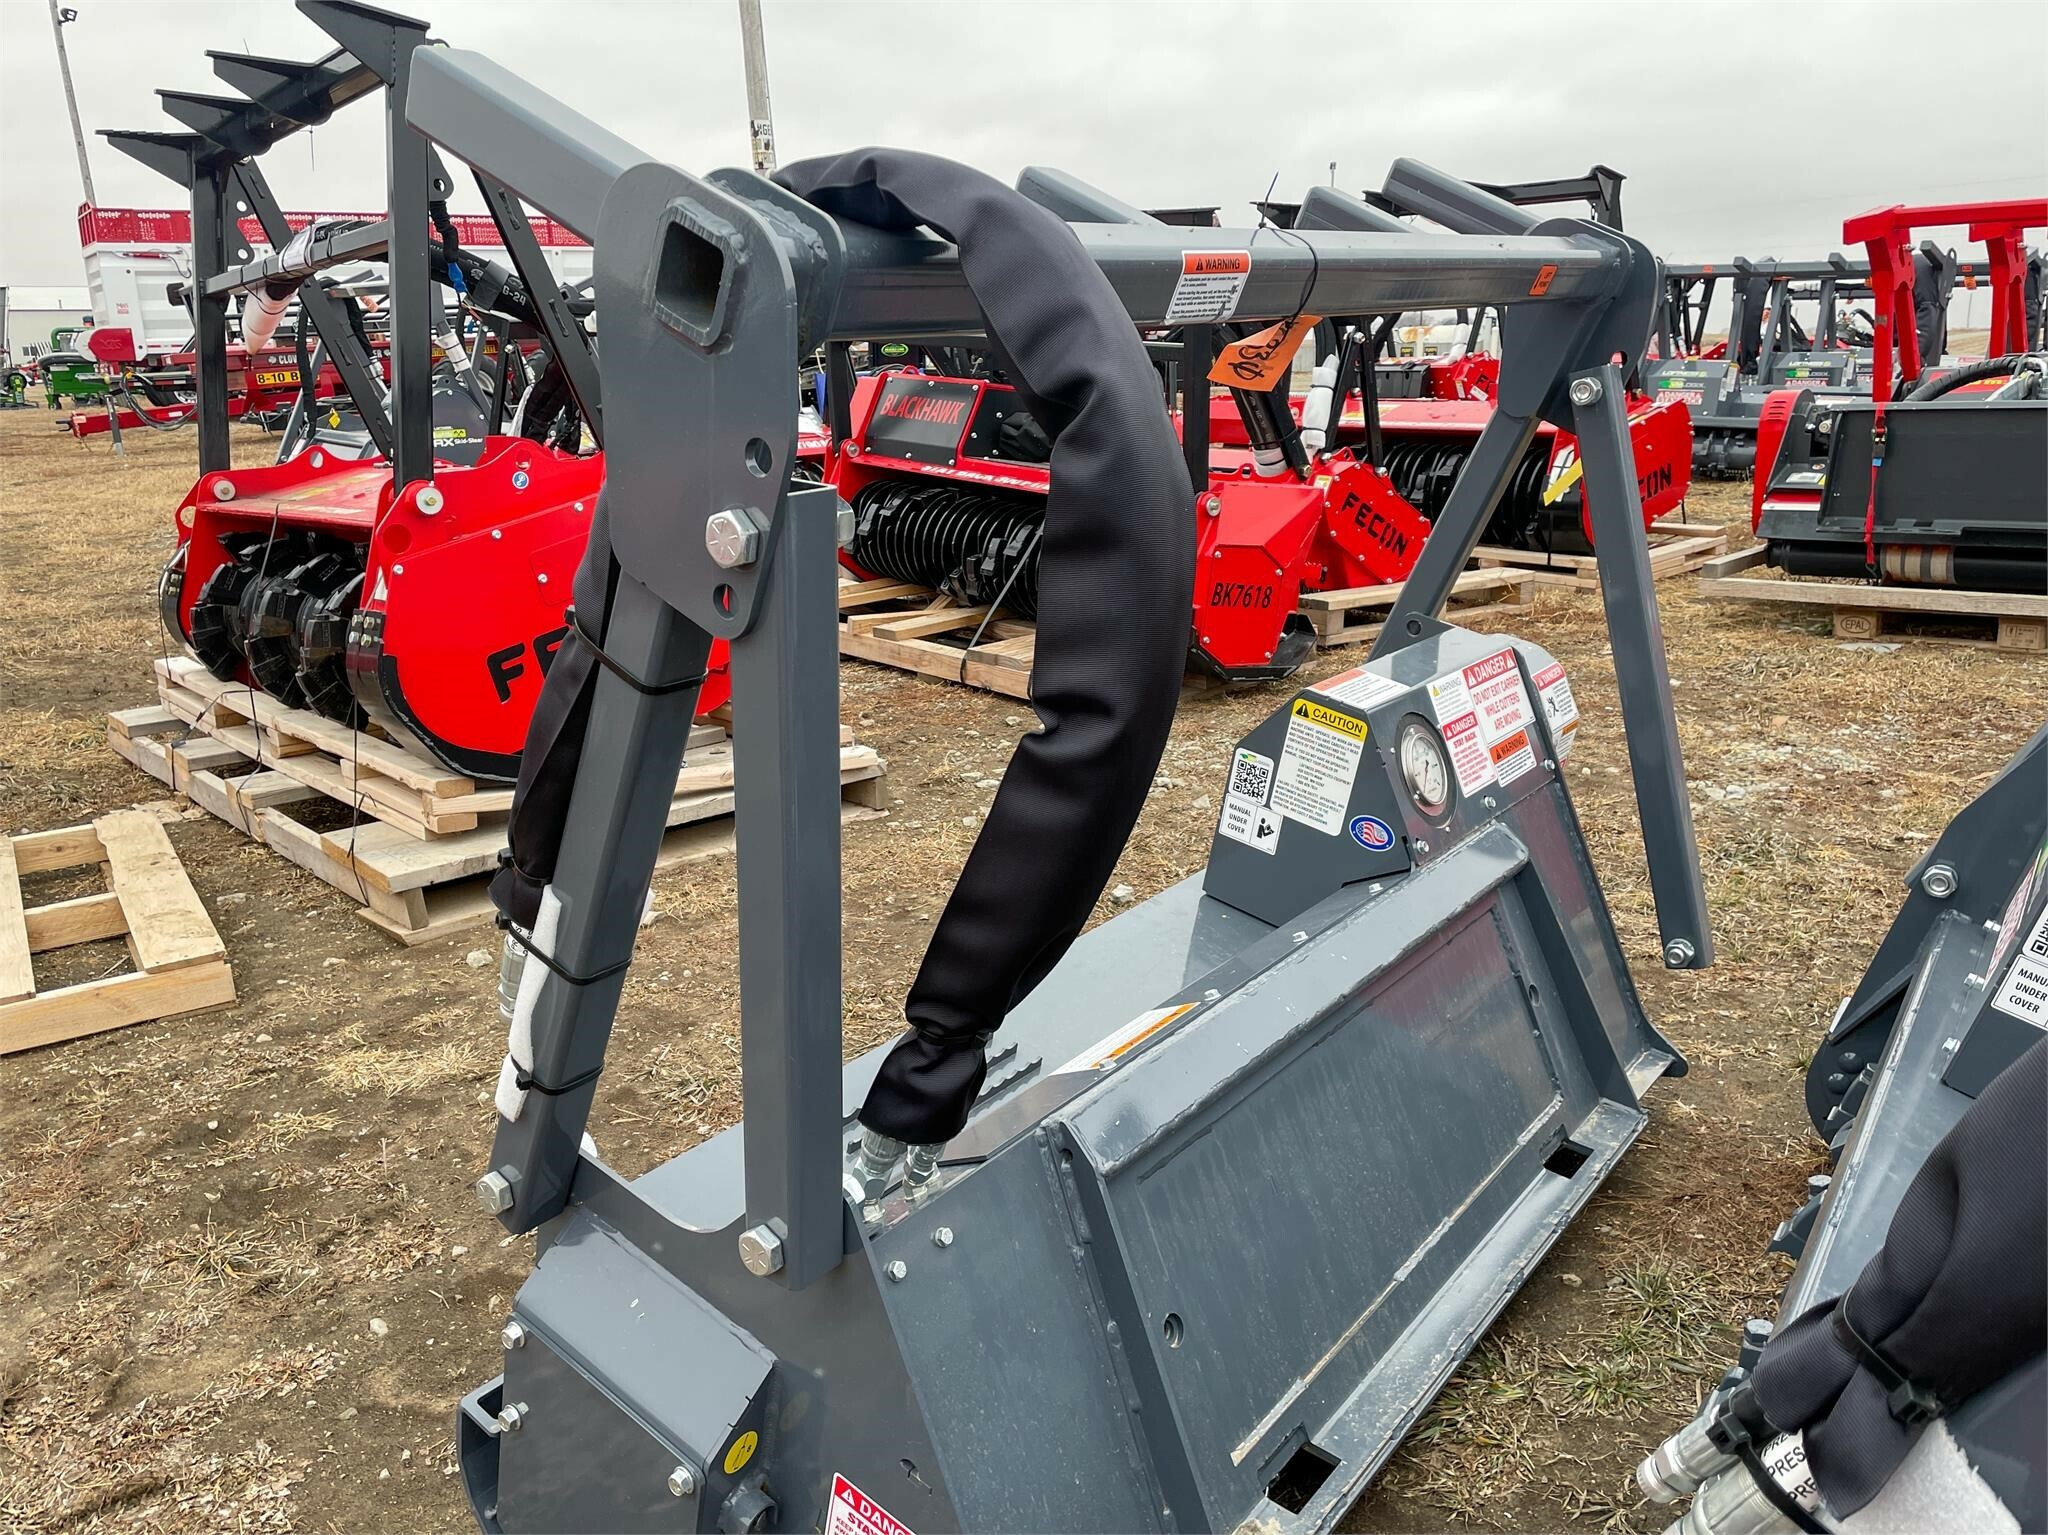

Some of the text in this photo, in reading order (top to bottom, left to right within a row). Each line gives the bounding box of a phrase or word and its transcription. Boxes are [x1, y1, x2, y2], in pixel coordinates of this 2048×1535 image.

[1206, 258, 1241, 270] WARNING
[502, 285, 526, 306] G-24
[258, 372, 285, 384] 8-10
[880, 394, 965, 425] BLACKHAWK
[1341, 491, 1408, 558] FECON
[1211, 582, 1273, 609] BK7618
[1845, 617, 1867, 630] EPAL
[1474, 656, 1507, 680] DANGER
[1473, 692, 1482, 705] DO
[1481, 687, 1492, 701] NOT
[1491, 683, 1501, 697] EXIT
[1484, 701, 1500, 717] WHILE
[1500, 692, 1520, 711] CUTTERS
[1313, 708, 1363, 733] CAUTION
[1451, 715, 1476, 733] DANGER
[1495, 709, 1521, 730] ARE MOVING
[1464, 732, 1476, 743] BACK
[1500, 735, 1525, 756] WARNING
[1228, 813, 1248, 825] UNDER
[1229, 803, 1251, 817] MANUAL
[1227, 823, 1246, 834] COVER
[2015, 981, 2048, 1002] UNDER
[2009, 995, 2040, 1014] COVER
